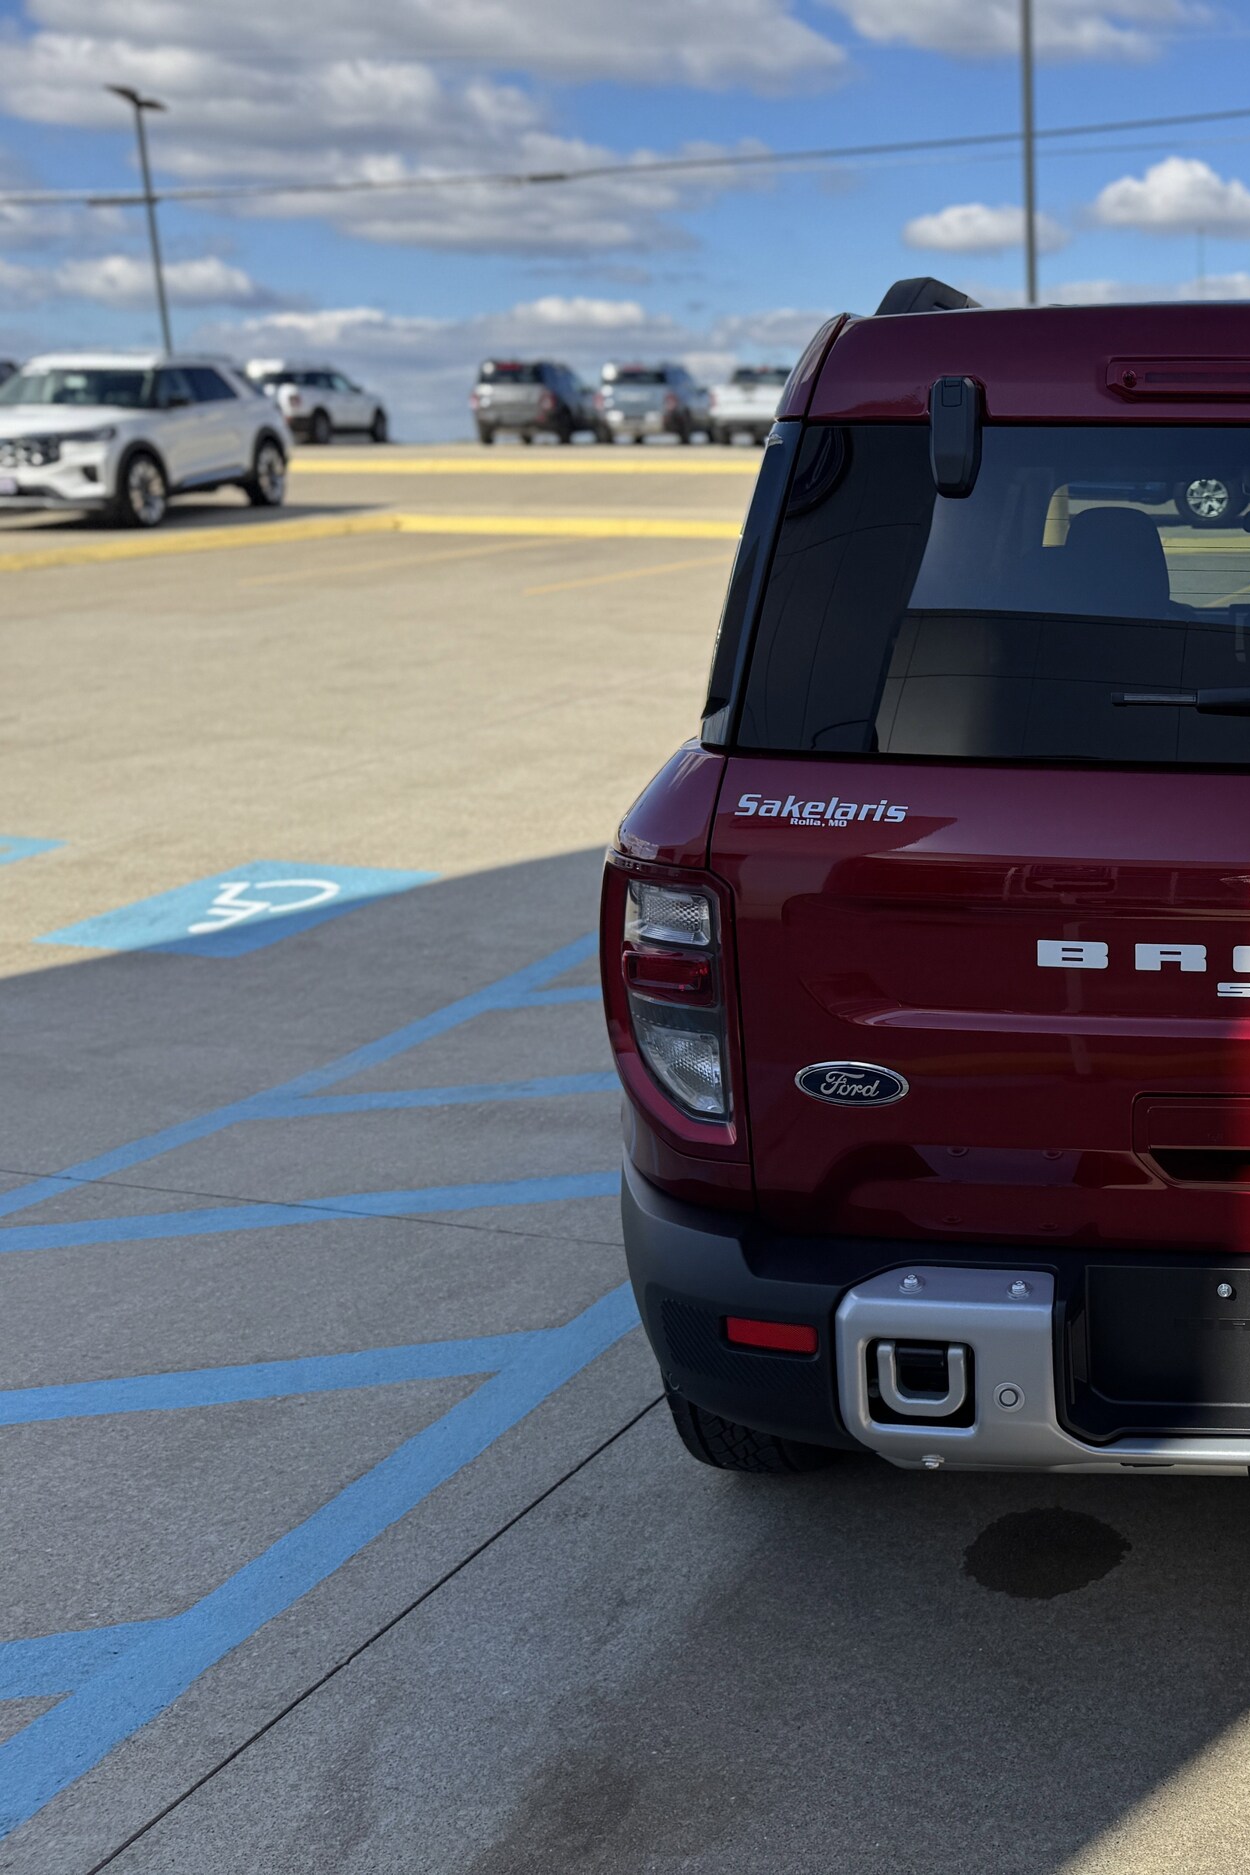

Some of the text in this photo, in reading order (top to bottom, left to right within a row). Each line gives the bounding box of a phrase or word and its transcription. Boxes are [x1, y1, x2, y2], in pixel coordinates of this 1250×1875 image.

[734, 793, 909, 823] Sakelaris
[790, 817, 848, 828] Rolla, MO
[820, 1071, 881, 1097] Ford
